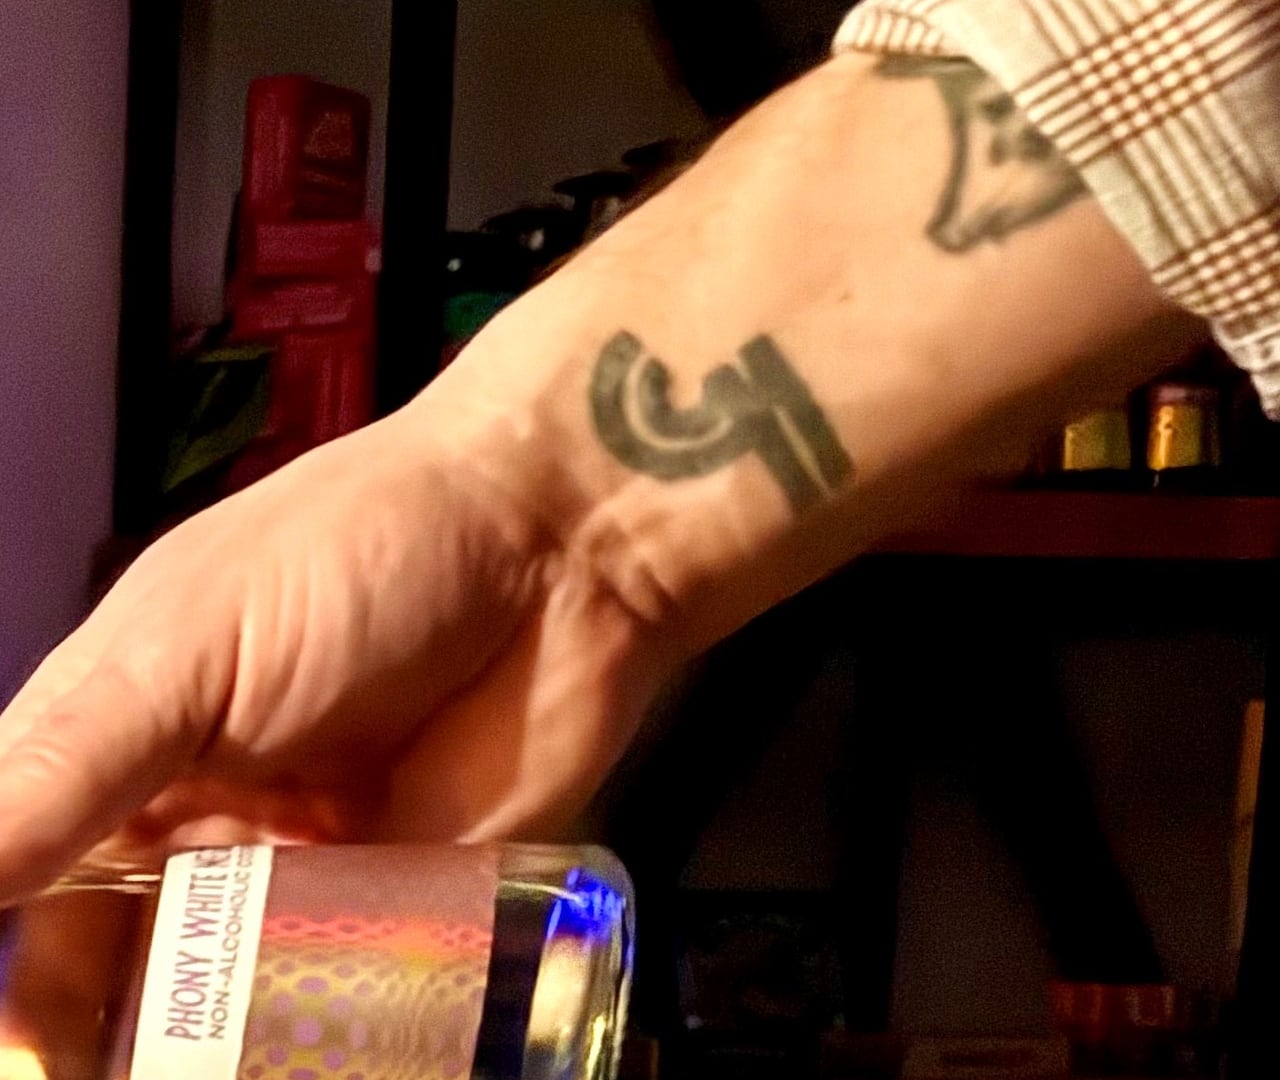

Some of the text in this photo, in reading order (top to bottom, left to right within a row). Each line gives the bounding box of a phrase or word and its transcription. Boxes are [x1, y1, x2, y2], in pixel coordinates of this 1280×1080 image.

[179, 873, 228, 939] WHITE
[164, 950, 214, 1041] PHONY
[208, 872, 251, 1040] NON-ALCOHOLIC
